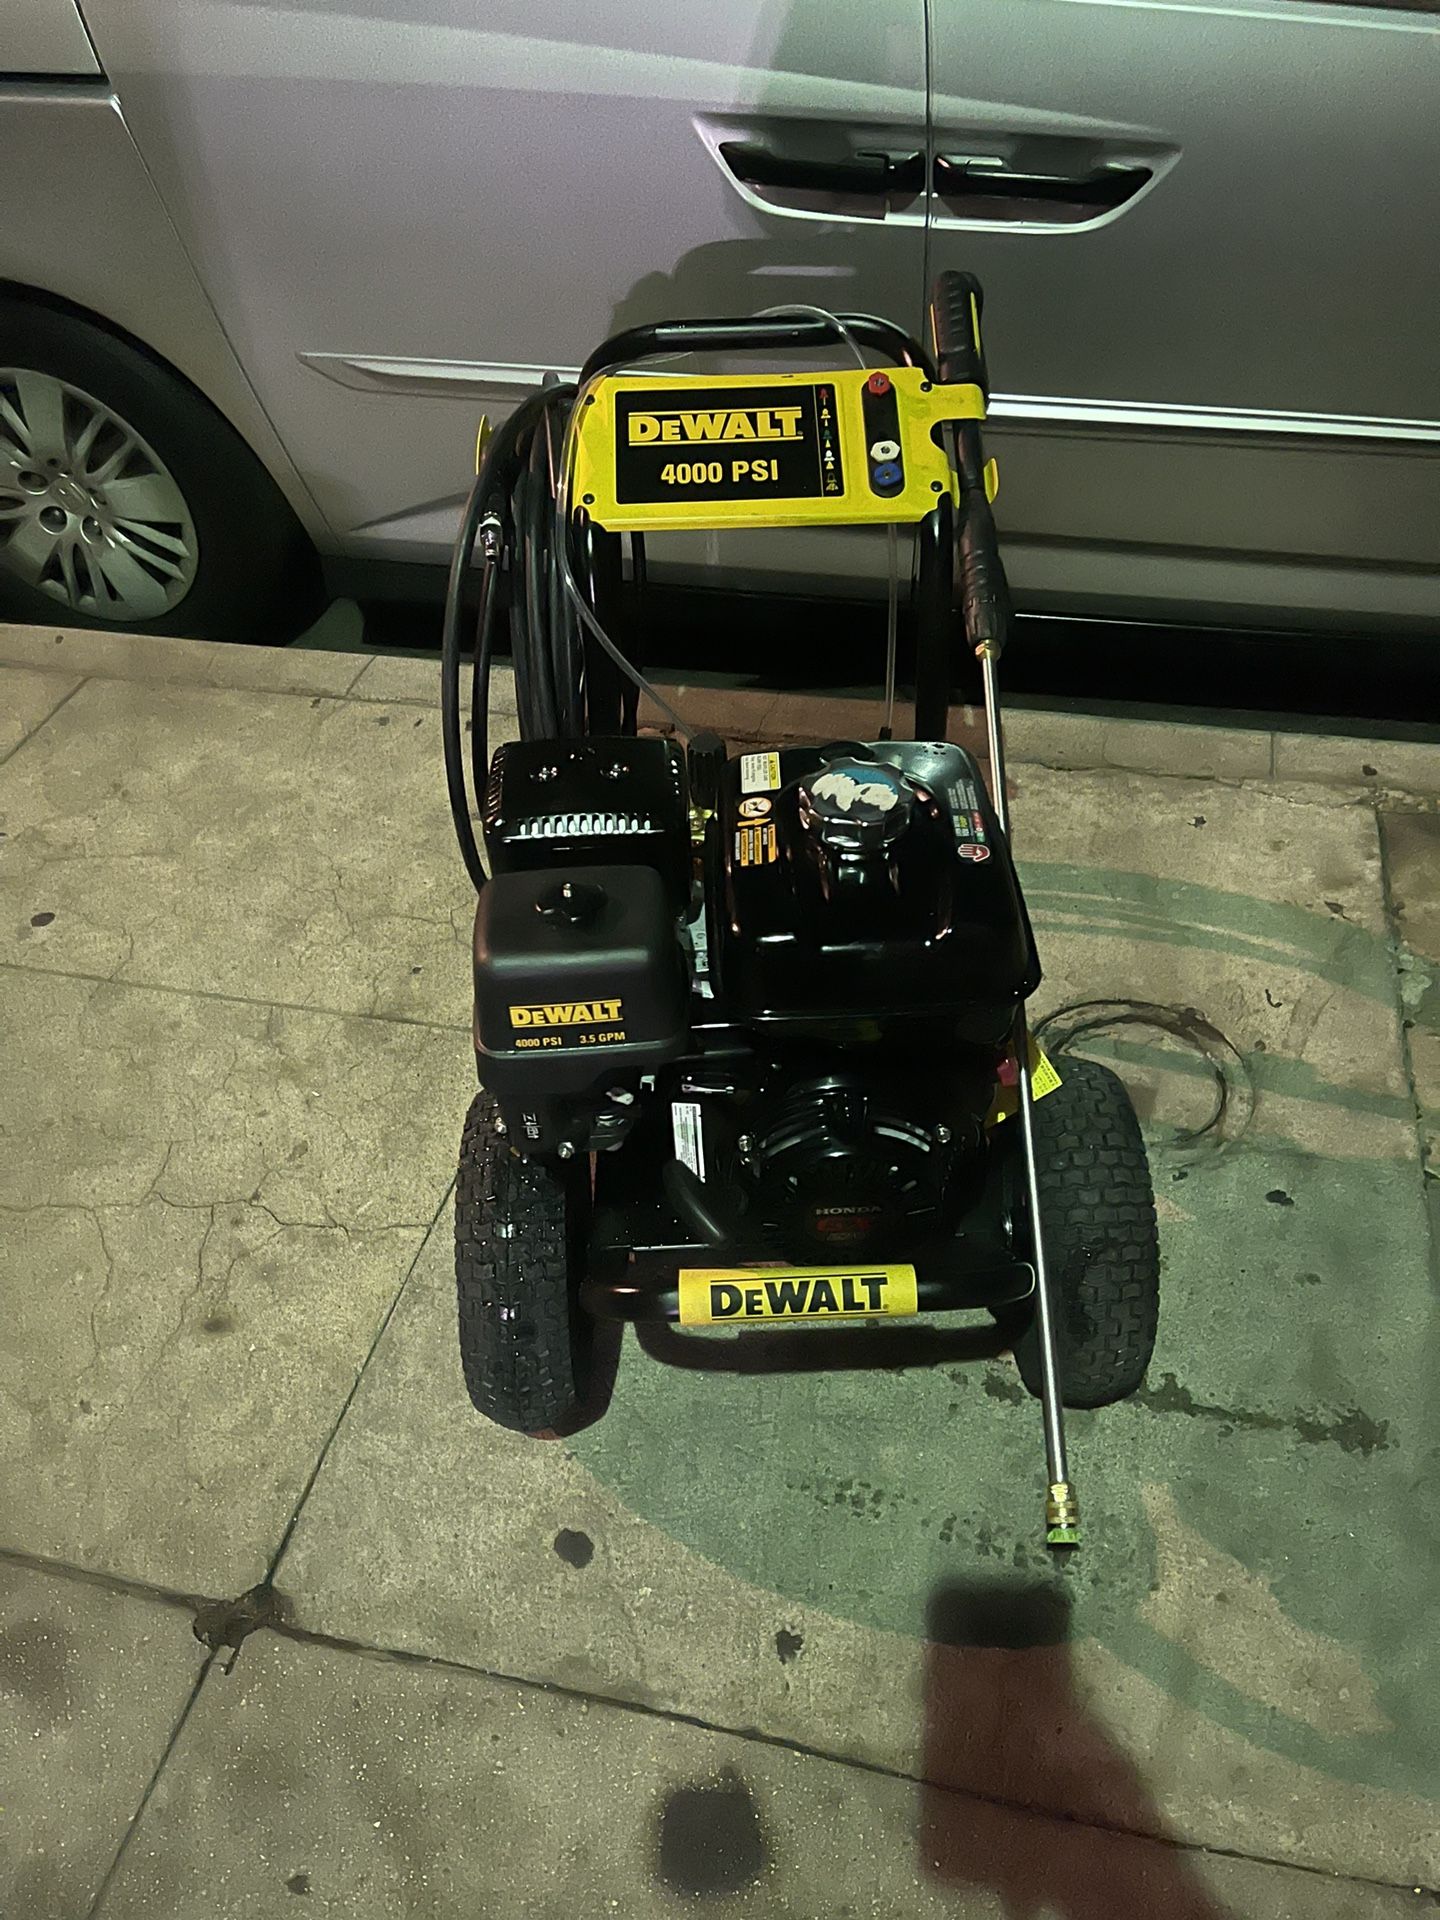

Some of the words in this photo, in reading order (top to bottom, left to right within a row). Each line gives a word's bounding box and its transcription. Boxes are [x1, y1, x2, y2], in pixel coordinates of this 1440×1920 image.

[660, 463, 723, 484] 4000
[732, 459, 779, 482] PSI
[515, 1038, 540, 1048] 4000
[542, 1036, 562, 1046] PSI
[579, 1034, 596, 1044] 3.5
[599, 1032, 626, 1042] GPM
[815, 1205, 883, 1215] HONDA
